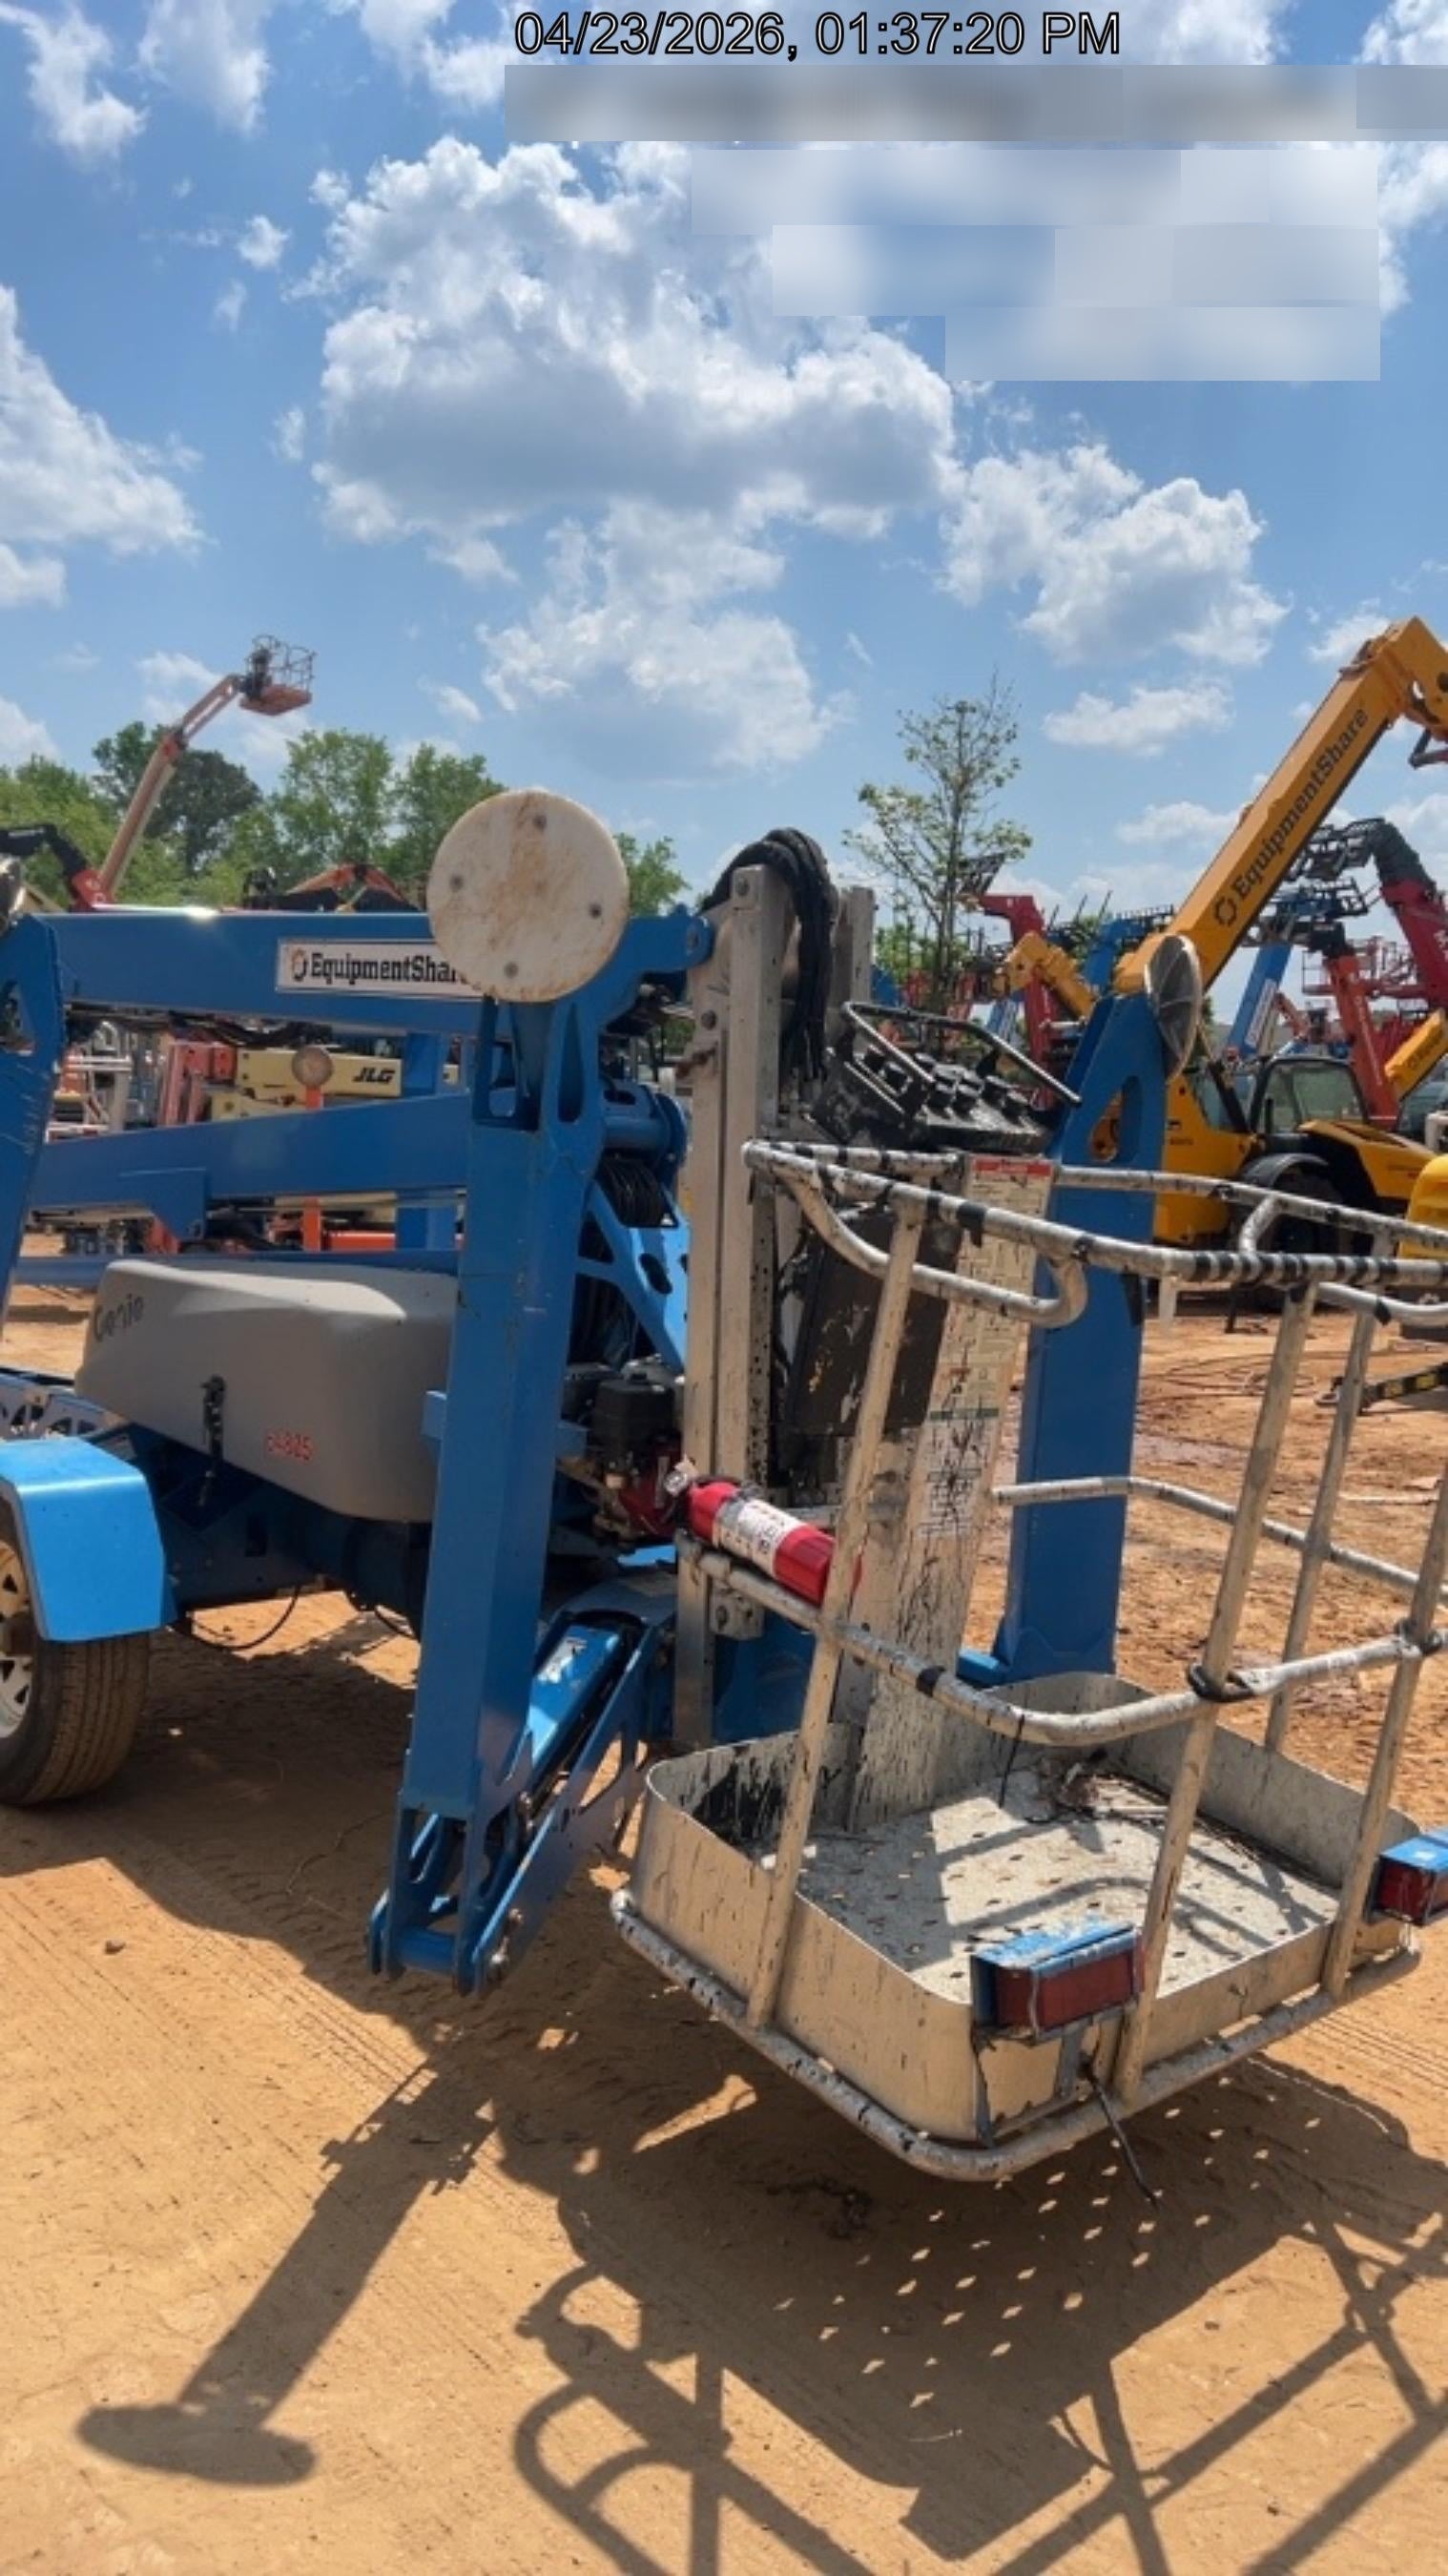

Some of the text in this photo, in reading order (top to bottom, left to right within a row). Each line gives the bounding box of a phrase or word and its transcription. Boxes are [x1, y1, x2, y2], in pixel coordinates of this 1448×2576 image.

[1231, 709, 1368, 899] EquipmentShare
[310, 952, 459, 986] EquipmentSha
[351, 1066, 396, 1086] JLG
[93, 1292, 145, 1342] Genie
